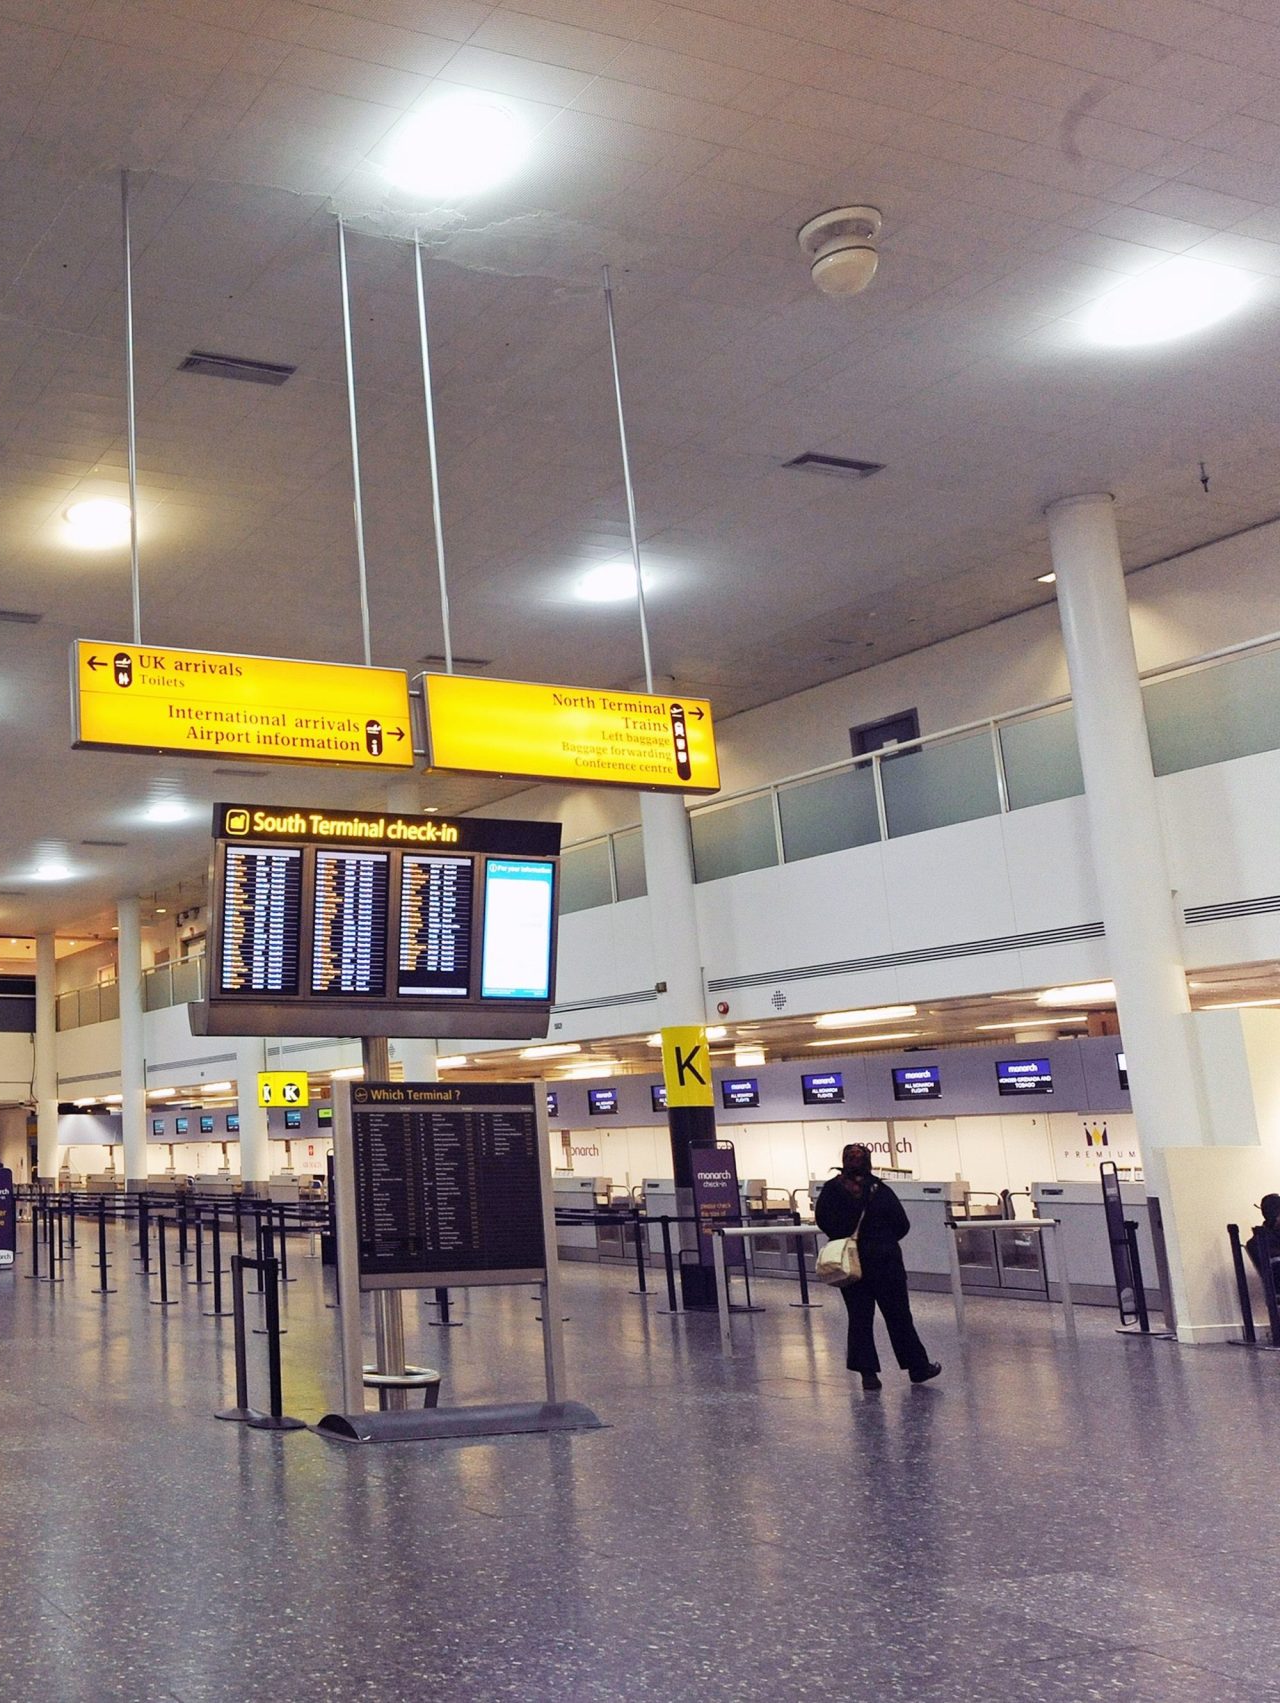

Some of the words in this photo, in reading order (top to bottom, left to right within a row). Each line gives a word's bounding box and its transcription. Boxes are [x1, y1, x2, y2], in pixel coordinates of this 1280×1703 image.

[138, 655, 166, 670] UK
[173, 657, 243, 677] arrivals
[140, 674, 185, 689] Toilets
[553, 693, 596, 710] North
[599, 697, 667, 716] Terminal
[168, 704, 286, 728] International
[294, 714, 361, 733] arrivals
[622, 717, 669, 733] Trains
[186, 725, 250, 746] Airport
[256, 728, 361, 752] information
[602, 730, 624, 742] Left
[626, 732, 671, 746] baggage
[561, 741, 606, 756] Baggage
[610, 746, 673, 762] forwarding
[574, 757, 637, 772] Conference
[639, 763, 673, 775] centre
[253, 811, 307, 834] South
[309, 815, 385, 839] Terminal
[386, 819, 458, 843] check-in
[674, 1045, 706, 1087] K
[284, 1085, 299, 1101] K
[370, 1089, 405, 1101] Which
[406, 1089, 452, 1101] Terminal
[454, 1089, 461, 1101] ?
[1064, 1150, 1136, 1159] PREMIUM
[697, 1169, 732, 1180] monarch
